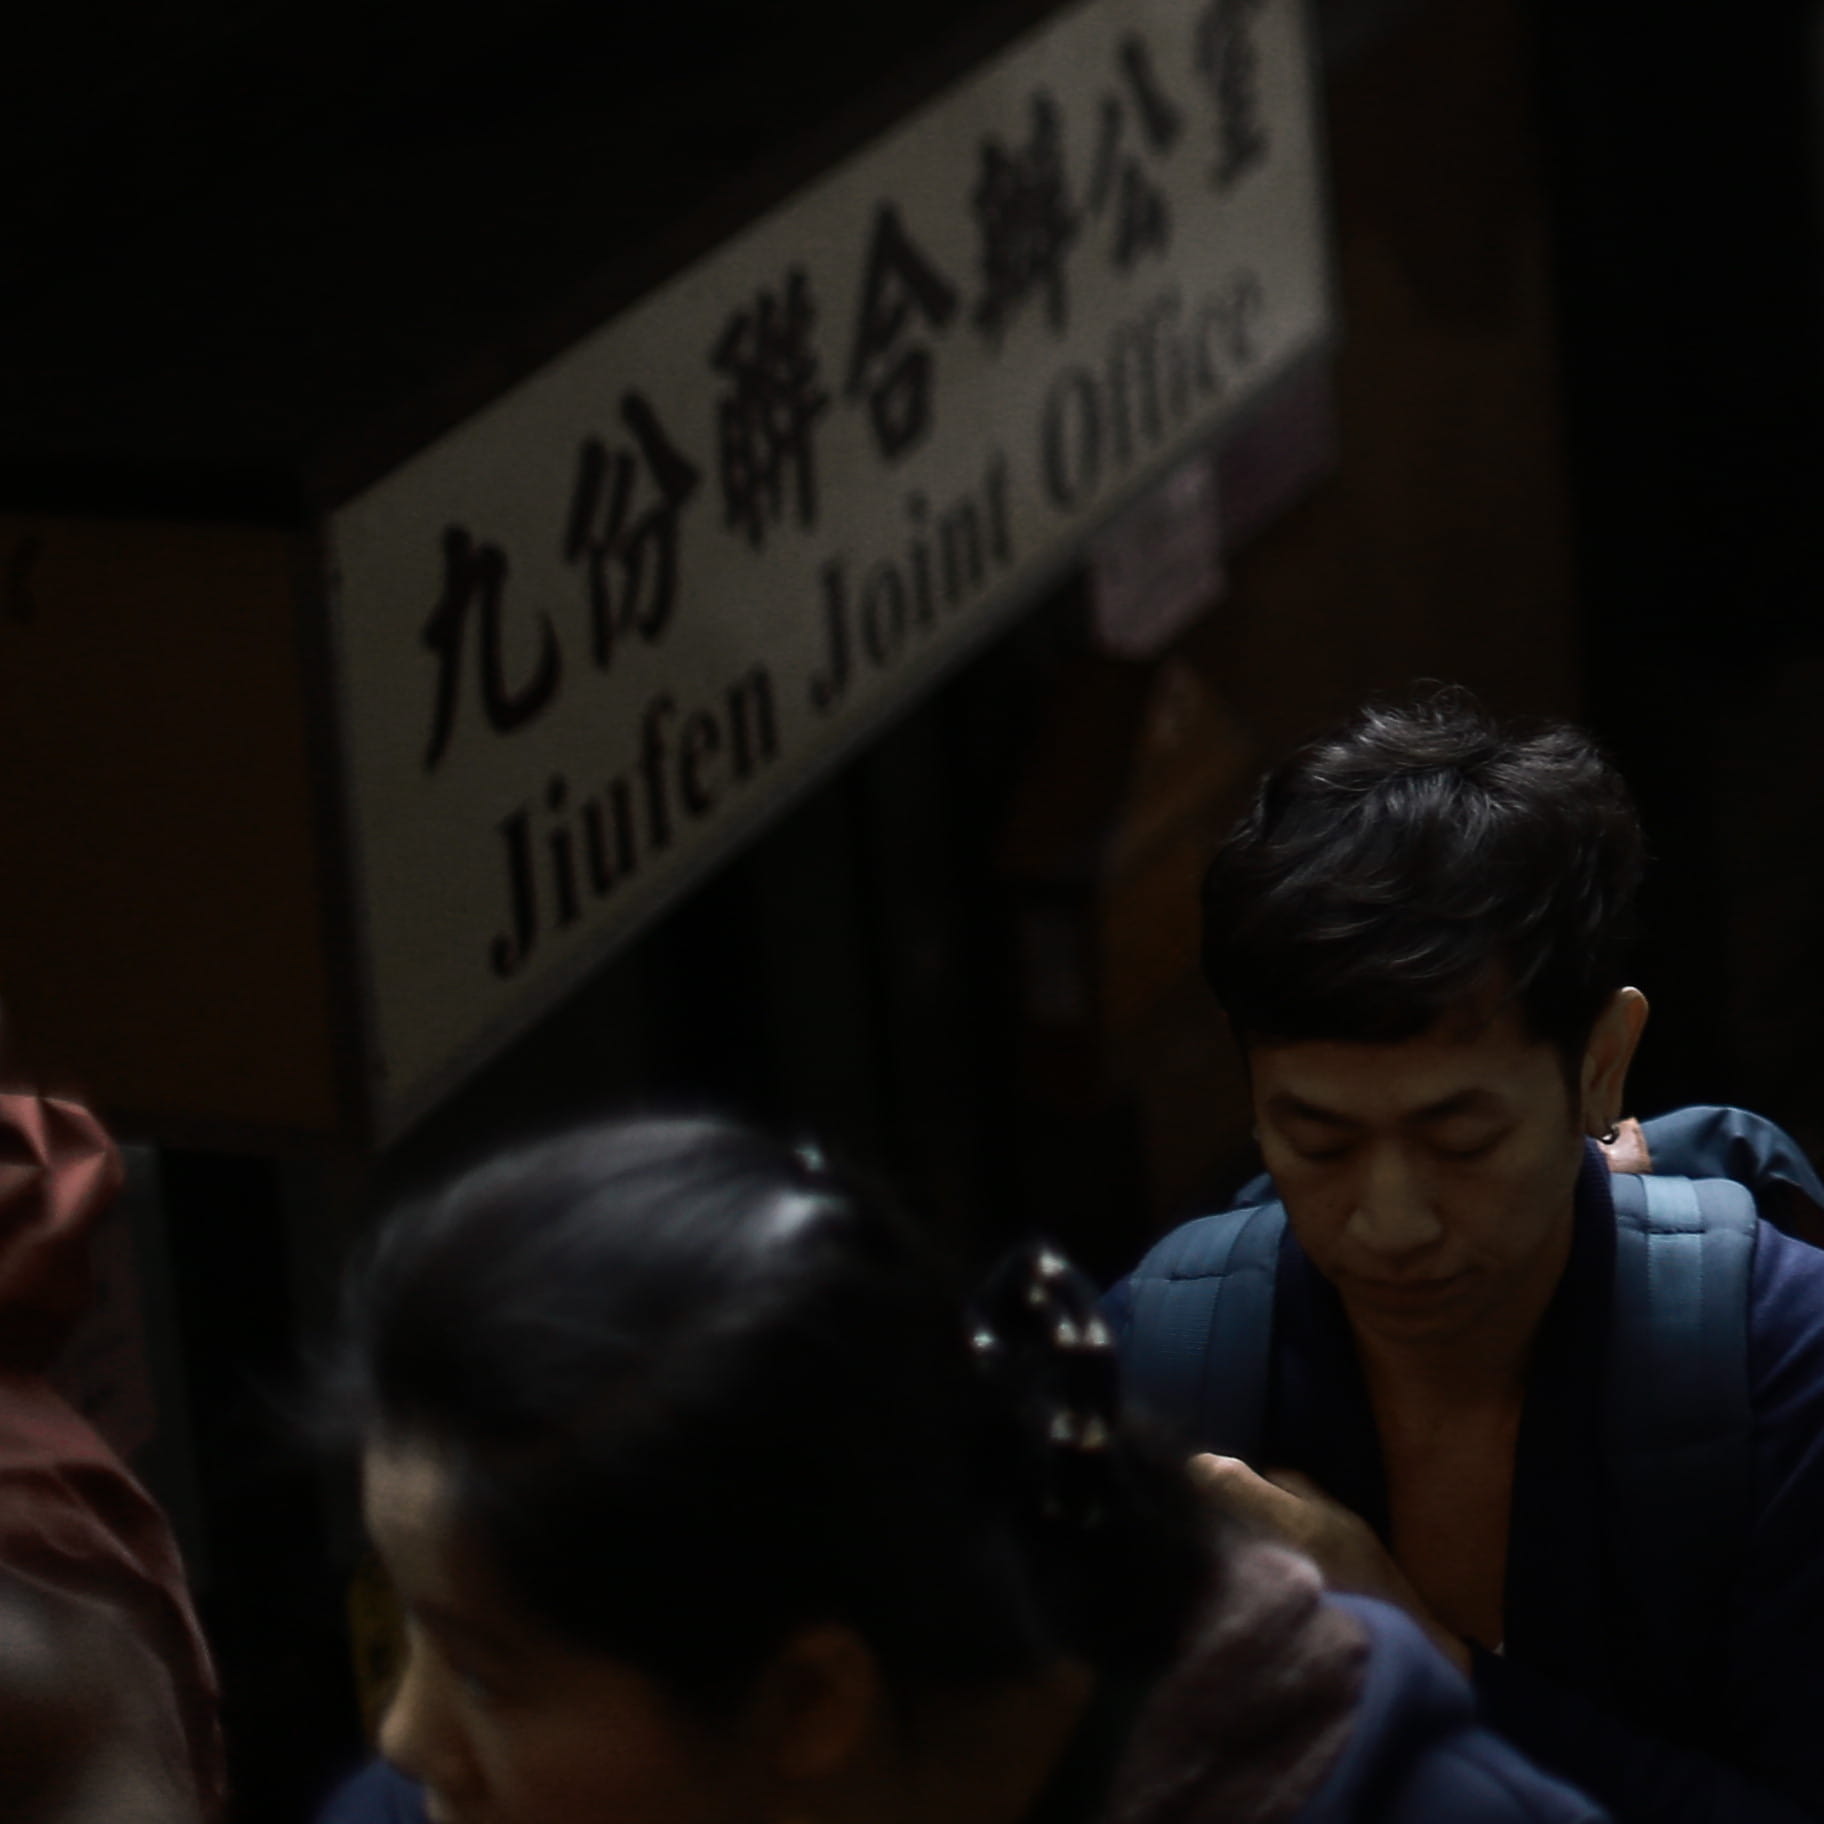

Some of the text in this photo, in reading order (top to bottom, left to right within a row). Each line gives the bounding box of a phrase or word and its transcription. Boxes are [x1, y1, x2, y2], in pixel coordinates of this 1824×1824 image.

[490, 268, 1262, 976] Jiufen Joint Office
